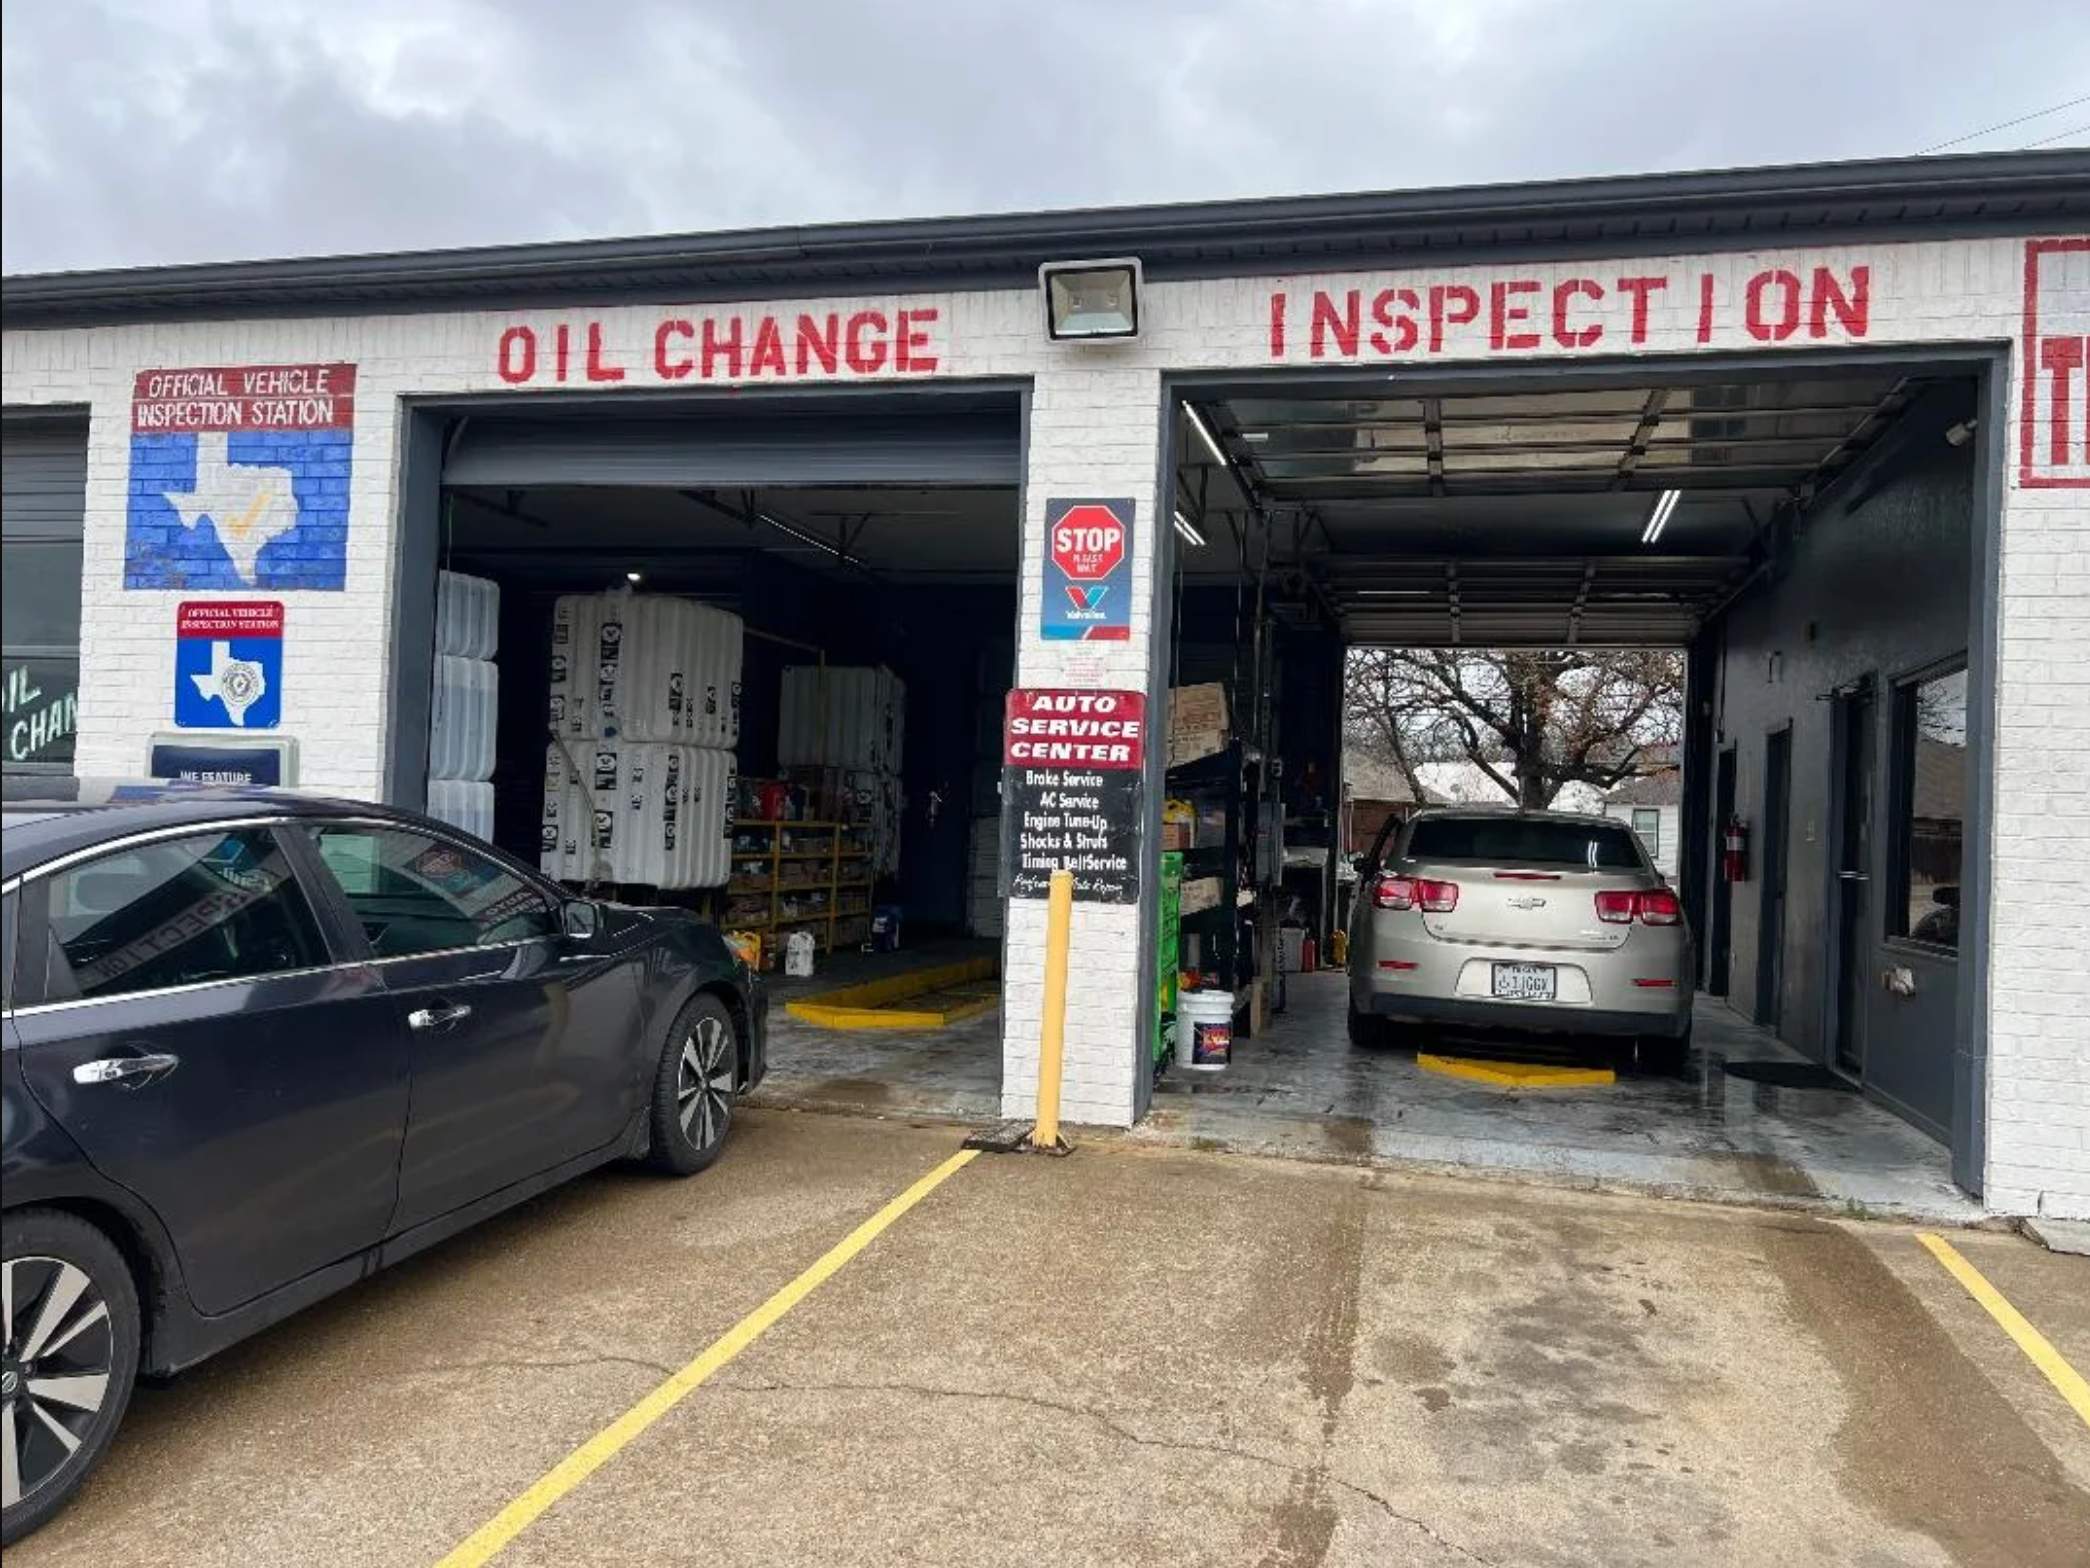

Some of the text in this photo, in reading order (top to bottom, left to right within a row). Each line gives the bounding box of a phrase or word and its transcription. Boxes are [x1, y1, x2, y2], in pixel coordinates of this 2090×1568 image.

[1270, 265, 1871, 357] INSPECTION
[499, 308, 939, 383] OIL CHANGE
[149, 369, 329, 398] OFFICIAL VEHICLE
[2041, 336, 2090, 466] T
[137, 398, 333, 427] INSPECTION STATION
[1056, 527, 1121, 553] STOP
[187, 608, 231, 617] OFFICIAL
[2, 665, 42, 713] IL
[1031, 695, 1117, 713] AUTO
[1011, 717, 1140, 738] SERVICE
[1010, 741, 1131, 761] CENTER
[1025, 769, 1104, 787] Brake Service
[1040, 791, 1099, 809] AC Service
[1024, 811, 1107, 834] Engine Tune-Up
[1020, 832, 1108, 849] Shocks & Struts
[1022, 852, 1059, 872] Timing
